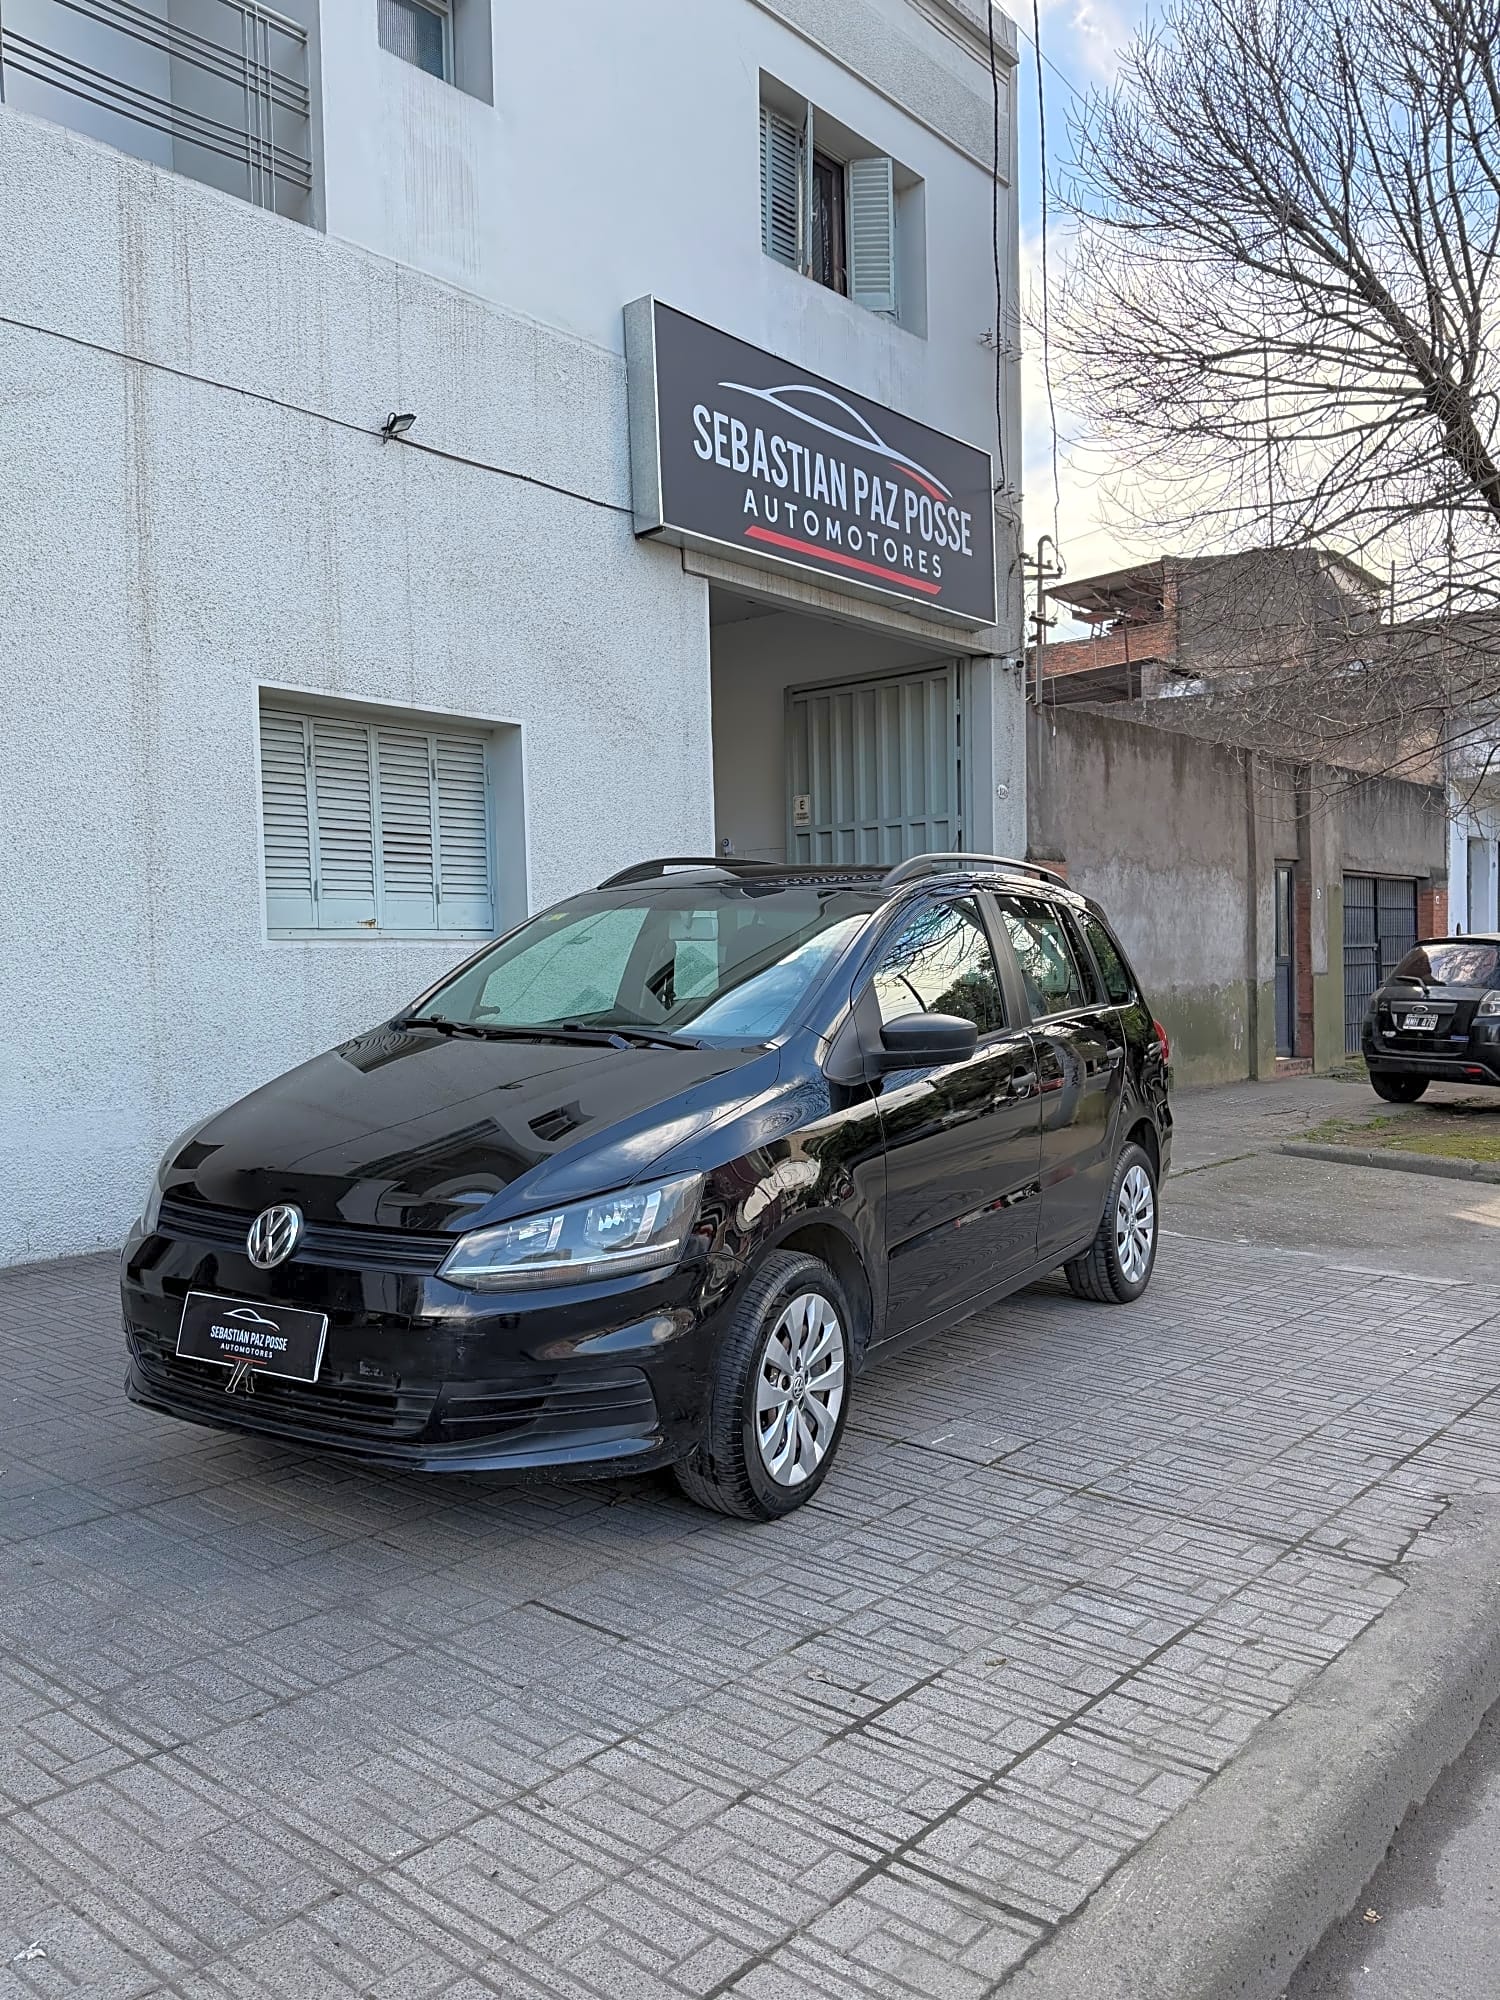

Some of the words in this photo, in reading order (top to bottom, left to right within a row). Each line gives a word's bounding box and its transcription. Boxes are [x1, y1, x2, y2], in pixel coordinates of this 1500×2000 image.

[693, 404, 847, 511] SEBASTIAN
[854, 468, 900, 530] PAZ
[905, 489, 973, 556] POSSE
[743, 489, 942, 578] AUTOMOTORES
[220, 1342, 273, 1358] AUTOMOTORES
[250, 1332, 265, 1347] PAZ
[265, 1335, 288, 1351] POSSE
